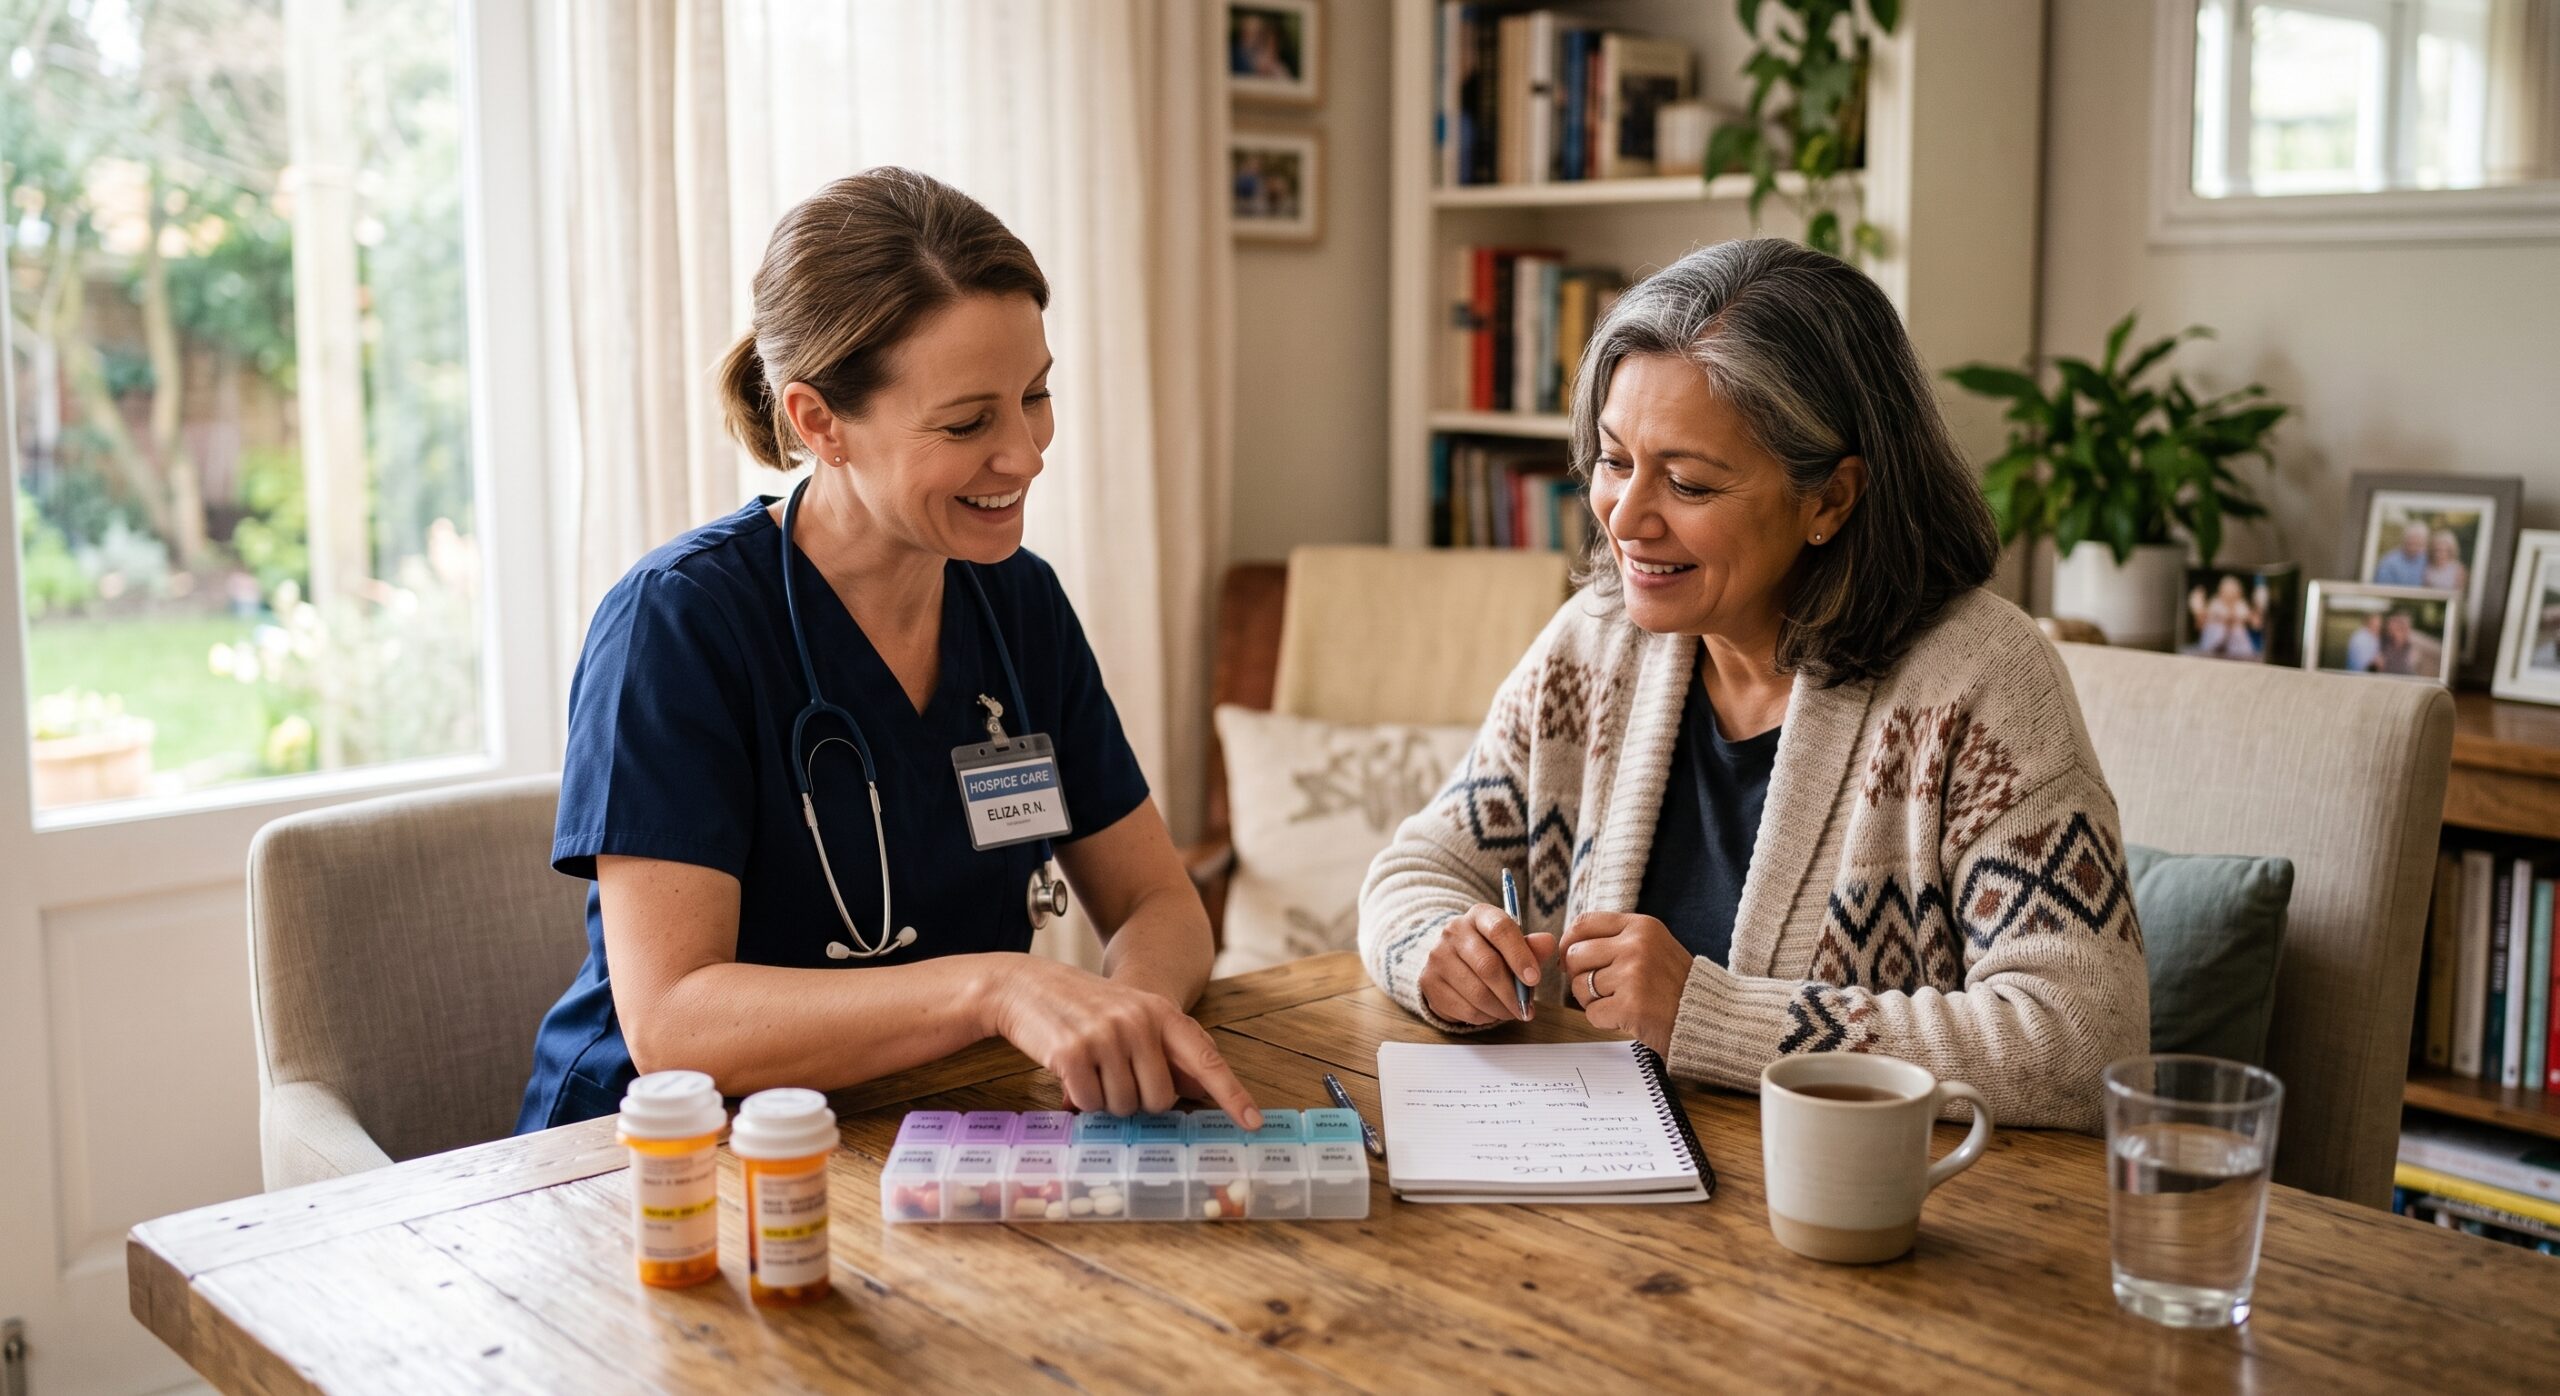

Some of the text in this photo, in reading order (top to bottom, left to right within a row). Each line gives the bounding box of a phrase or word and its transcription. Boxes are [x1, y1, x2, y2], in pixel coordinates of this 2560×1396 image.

[970, 770, 1049, 794] HOSPICE CARE
[987, 801, 1046, 821] ELIZA R.N.
[1513, 1166, 1563, 1175] LOG
